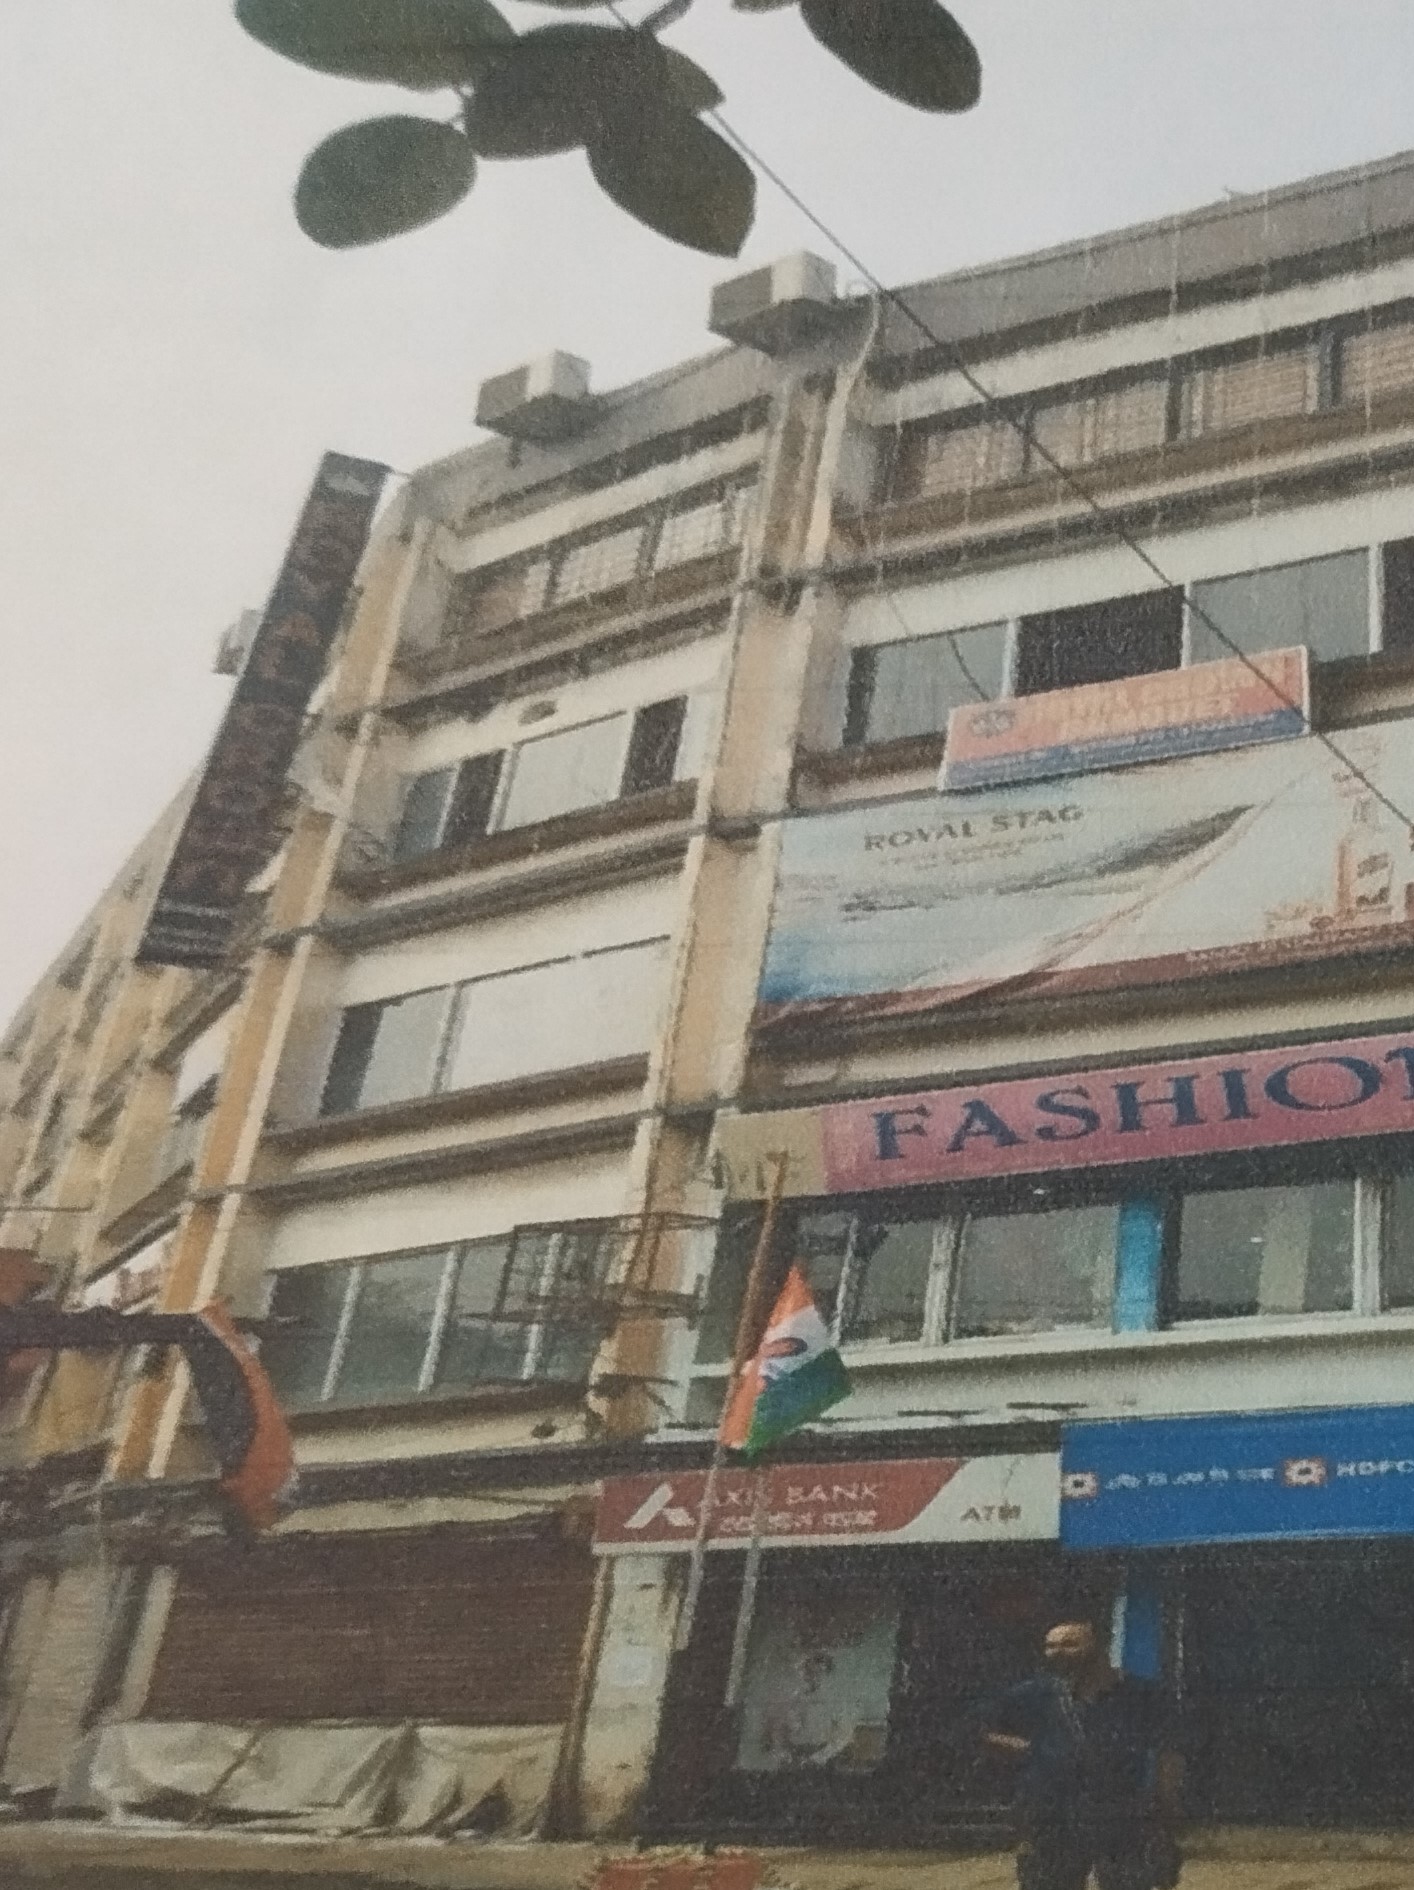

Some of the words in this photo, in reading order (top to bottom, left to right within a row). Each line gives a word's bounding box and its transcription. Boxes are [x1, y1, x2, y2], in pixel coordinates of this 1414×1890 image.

[864, 819, 975, 851] ROYAL
[991, 803, 1084, 833] STAG
[786, 1482, 881, 1505] BANK
